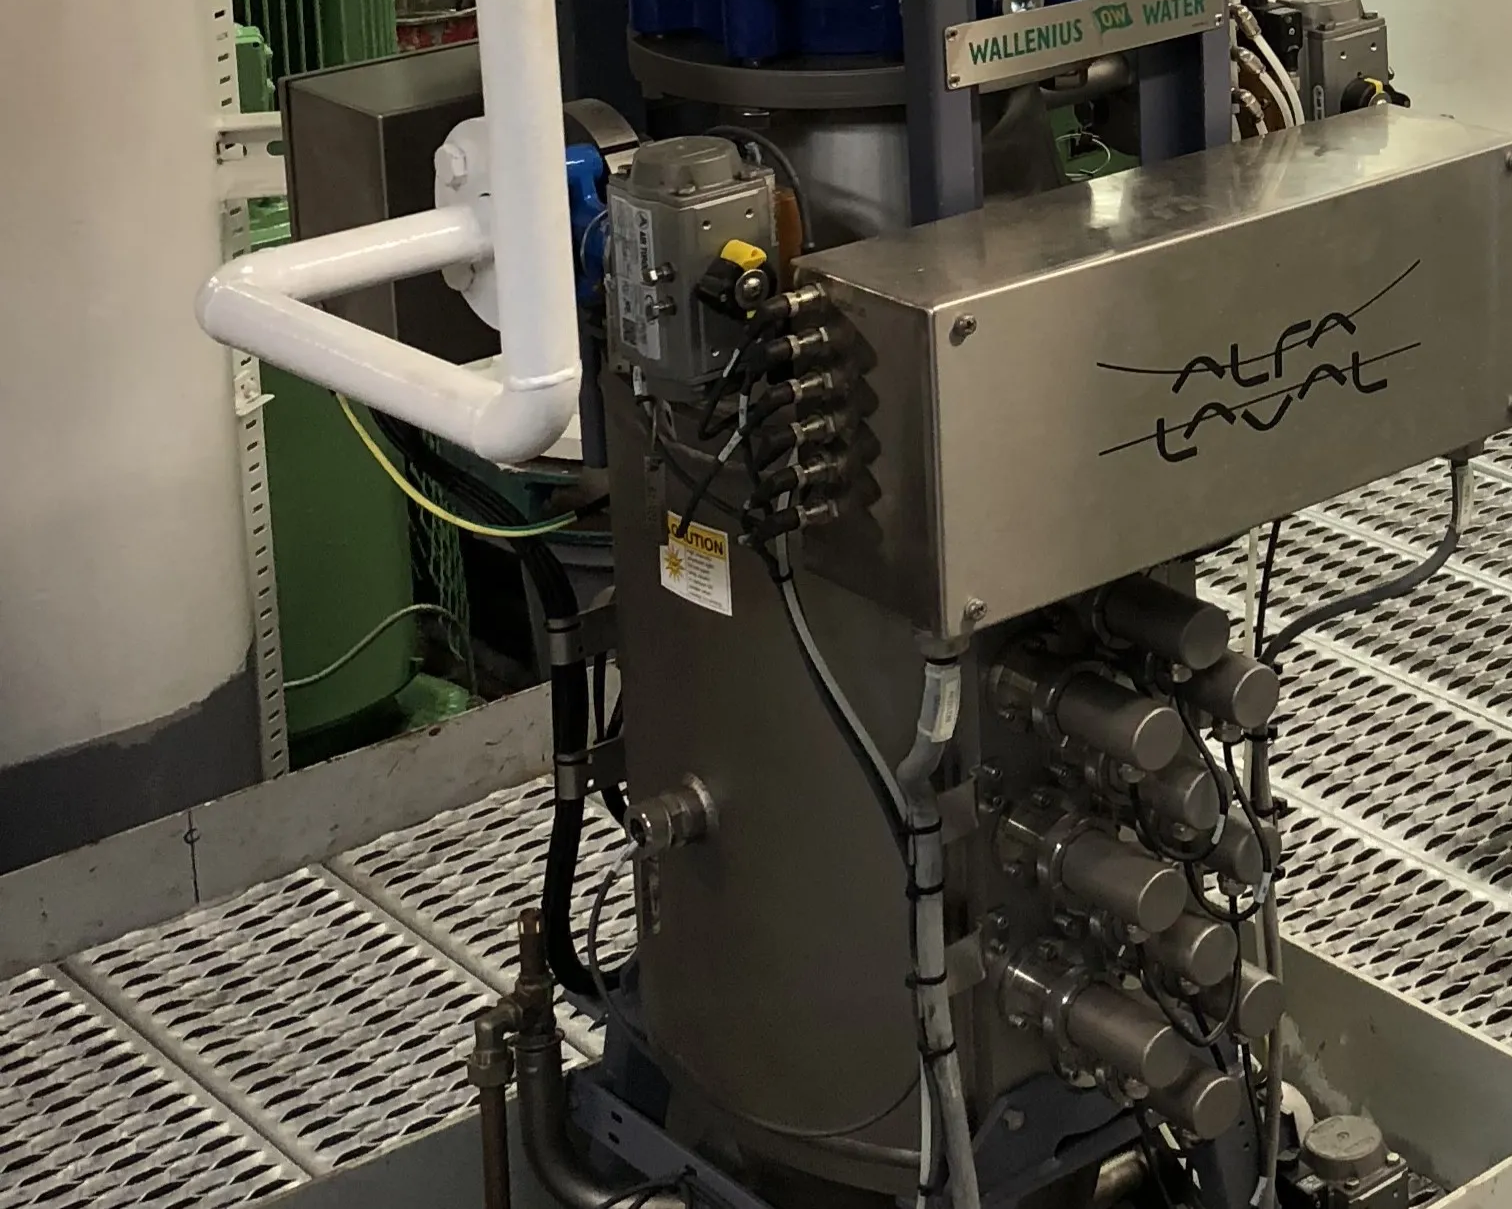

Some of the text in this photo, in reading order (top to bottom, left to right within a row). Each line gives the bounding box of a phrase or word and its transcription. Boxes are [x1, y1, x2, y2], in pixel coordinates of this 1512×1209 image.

[969, 19, 1083, 65] WALLENIUS
[1100, 8, 1127, 27] OW
[1172, 312, 1356, 393] ALFA
[1156, 351, 1388, 463] LAVAL
[671, 523, 724, 556] CUTION
